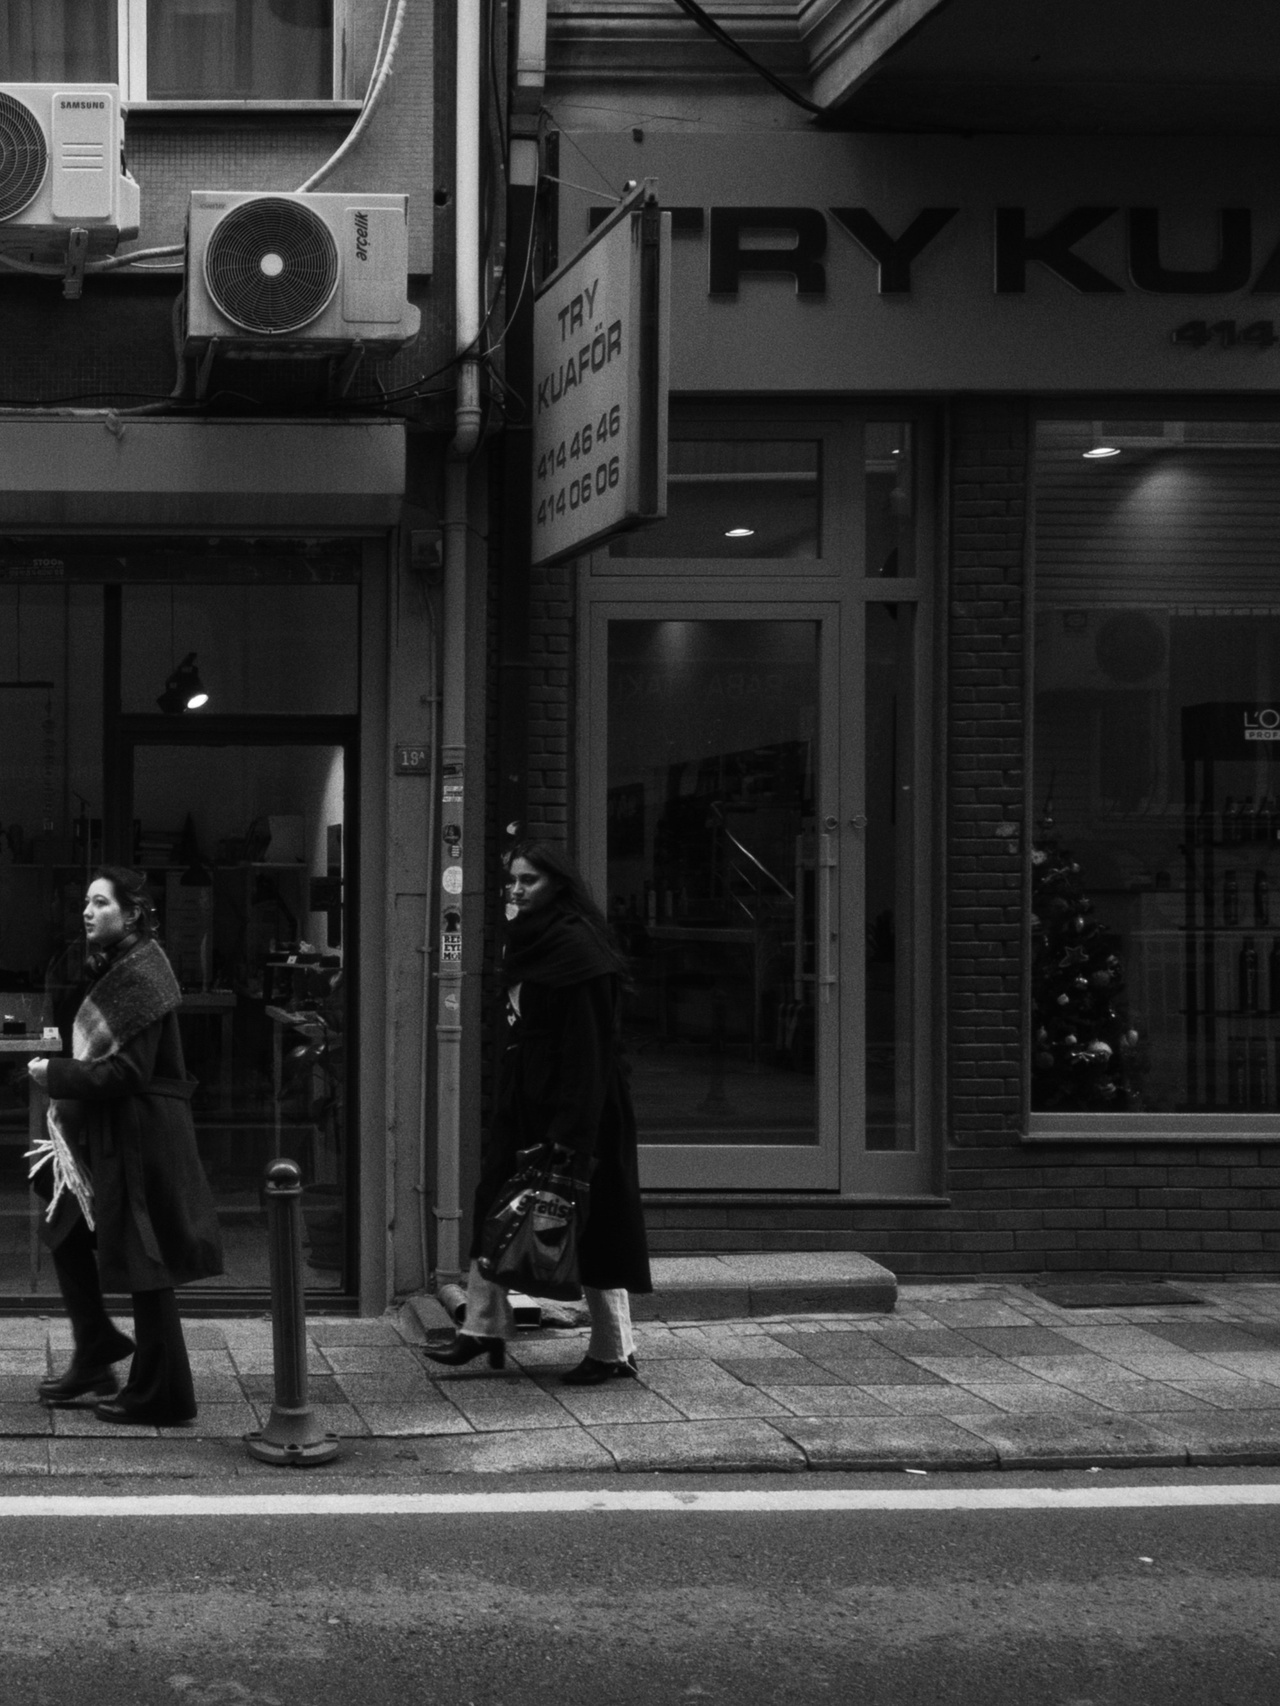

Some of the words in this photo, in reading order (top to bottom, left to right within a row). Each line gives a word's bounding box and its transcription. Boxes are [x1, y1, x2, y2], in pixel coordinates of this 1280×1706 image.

[60, 101, 105, 109] SAMSUNG
[354, 211, 371, 262] arçelik
[558, 278, 599, 342] TRY
[537, 319, 622, 414] KUAFÖR
[537, 440, 566, 481] 414
[570, 423, 592, 461] 46
[596, 404, 620, 443] 46
[537, 486, 566, 526] 414
[570, 472, 592, 511] 06
[595, 455, 620, 496] 06
